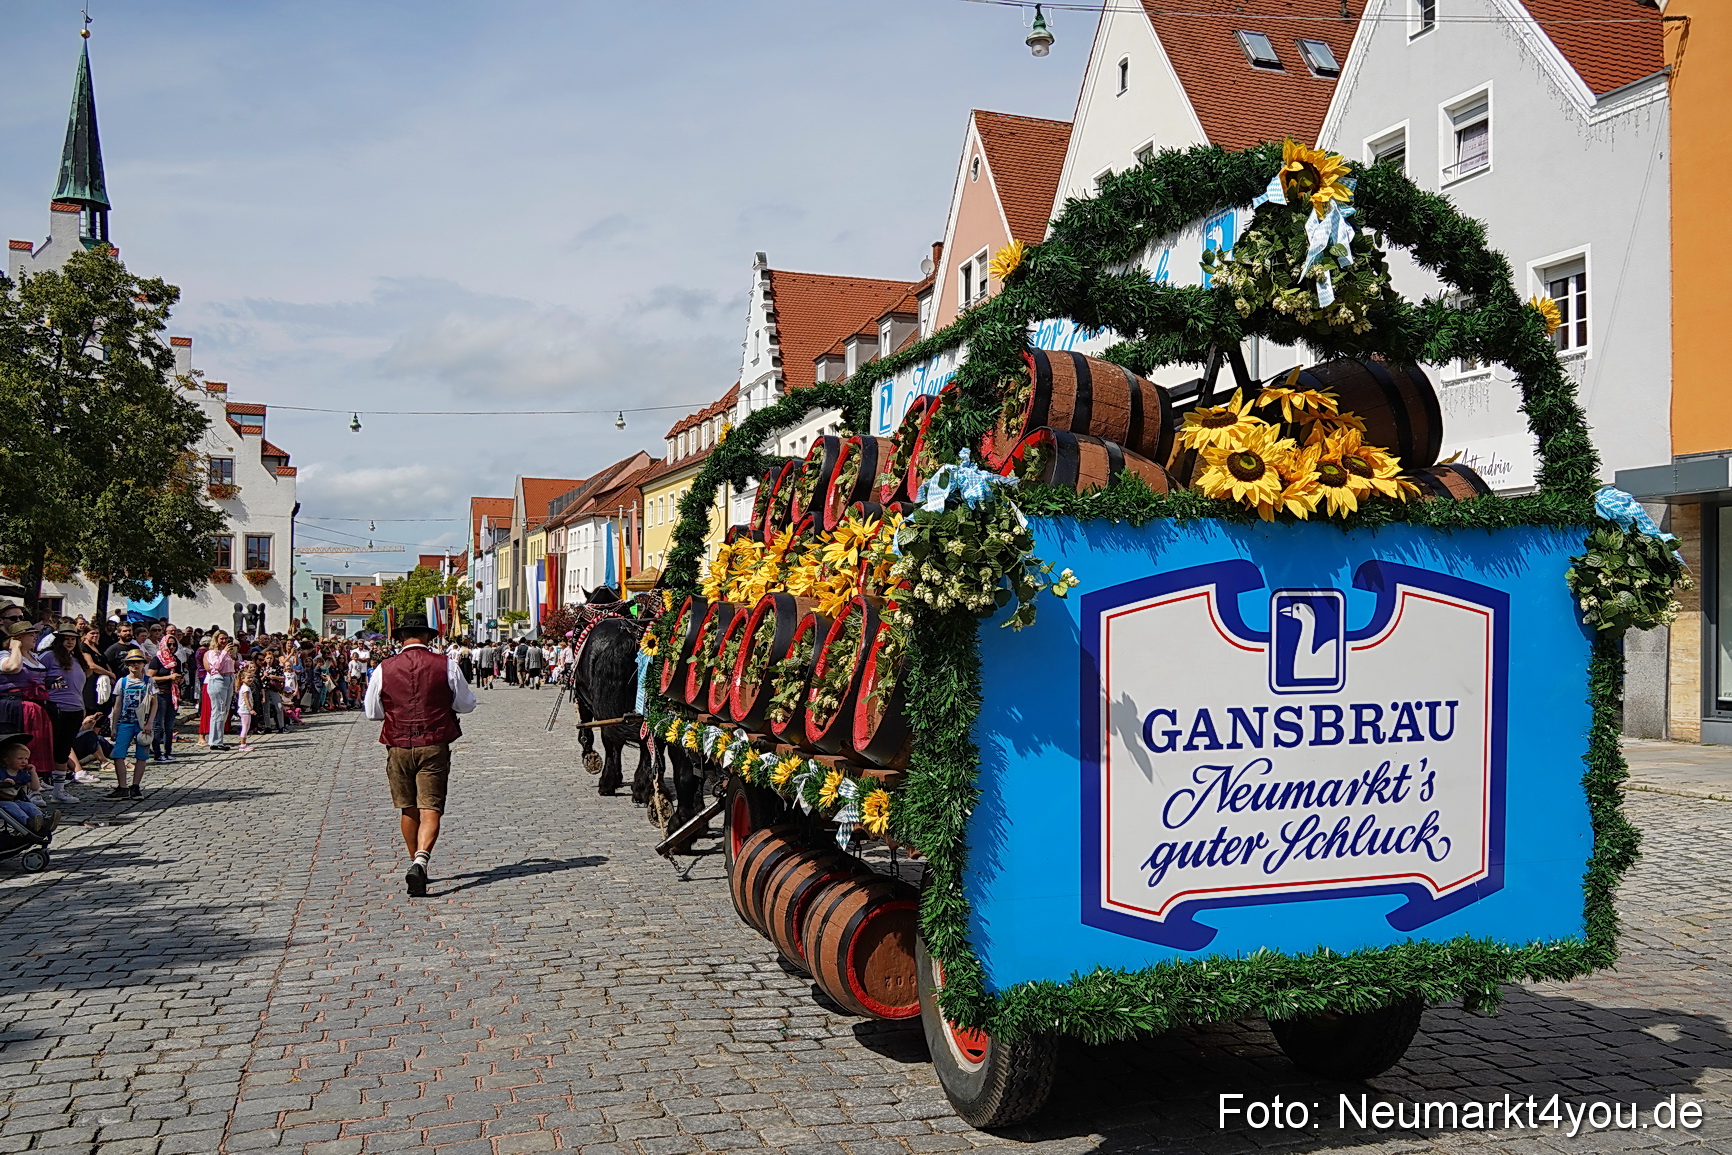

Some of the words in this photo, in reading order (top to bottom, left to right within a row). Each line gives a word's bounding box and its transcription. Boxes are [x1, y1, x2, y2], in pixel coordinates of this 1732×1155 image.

[1143, 700, 1459, 754] GANSBRÄU
[1162, 757, 1436, 830] Neumarkt's
[1140, 826, 1269, 888] guter
[1262, 809, 1452, 875] Schluck
